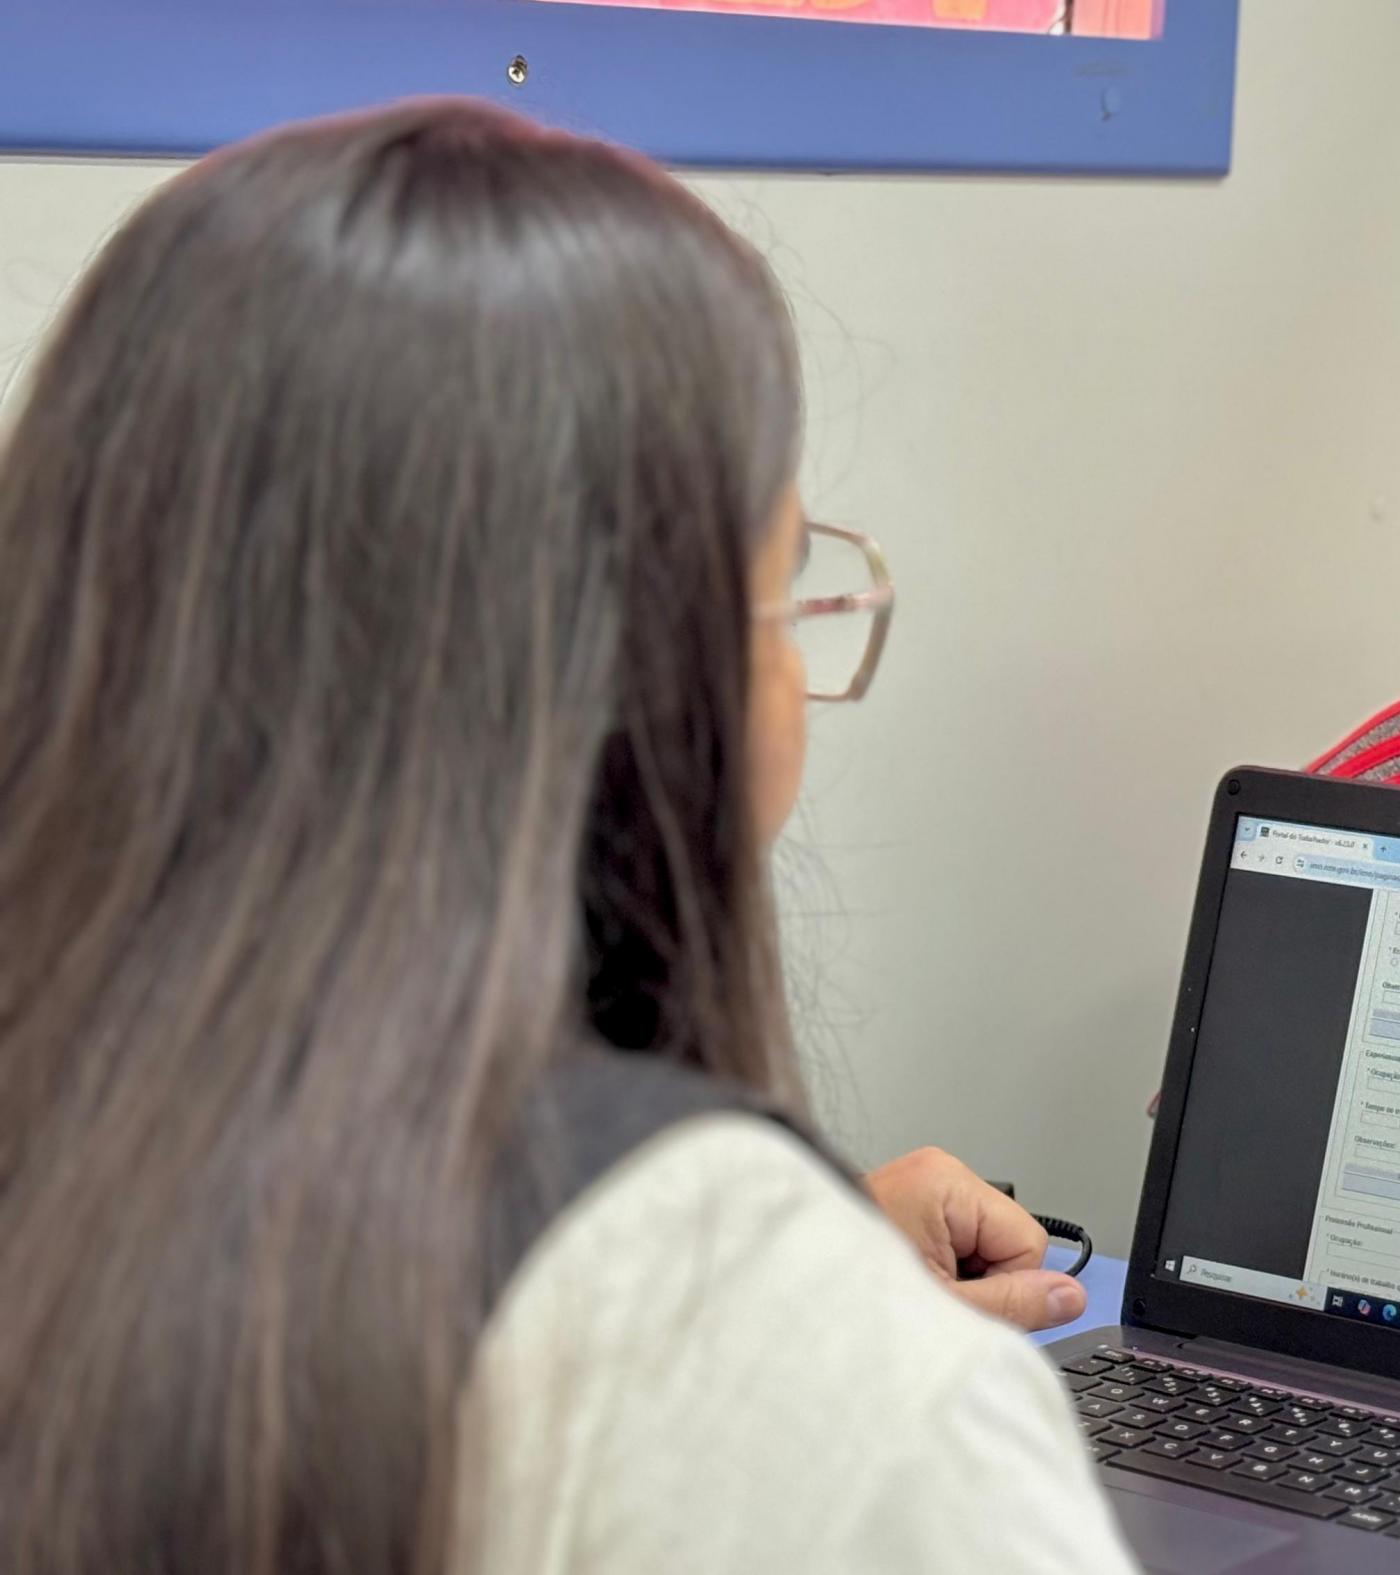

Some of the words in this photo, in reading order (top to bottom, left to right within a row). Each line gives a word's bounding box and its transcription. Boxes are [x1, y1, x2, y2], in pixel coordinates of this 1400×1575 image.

[1364, 1101, 1385, 1113] Tempo
[1360, 1275, 1370, 1284] de
[1370, 1277, 1395, 1289] trabalho
